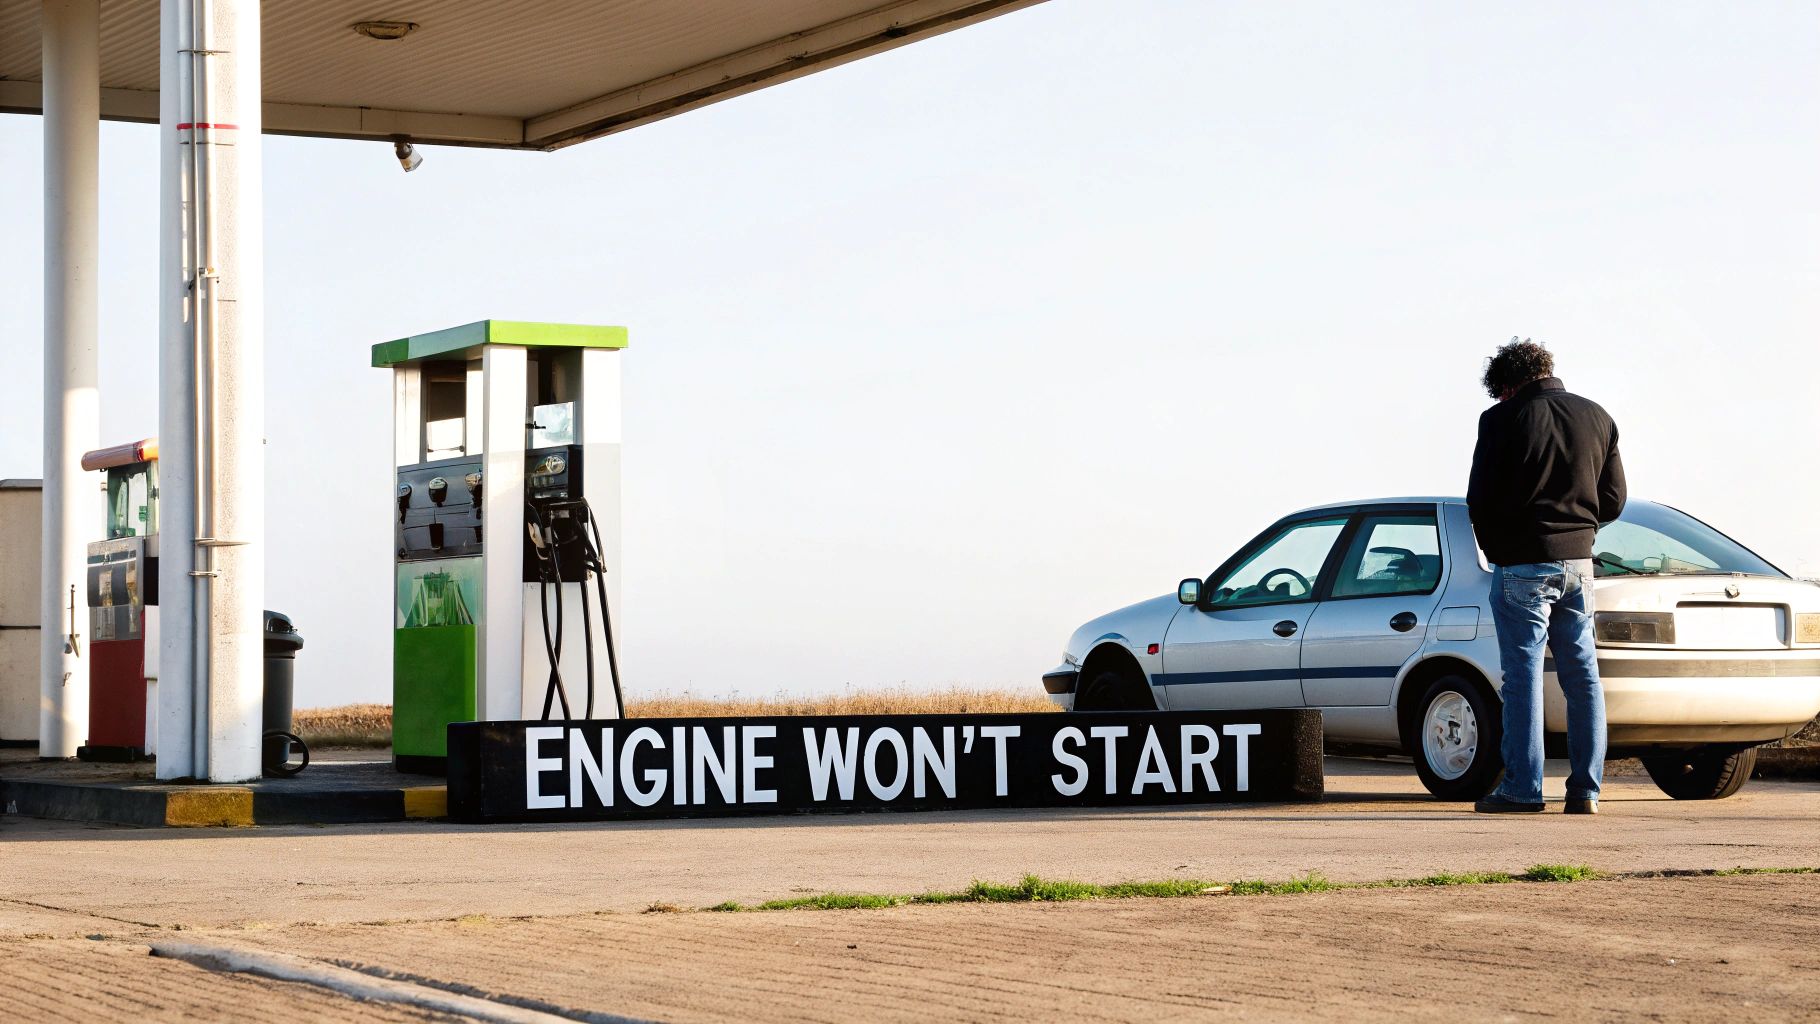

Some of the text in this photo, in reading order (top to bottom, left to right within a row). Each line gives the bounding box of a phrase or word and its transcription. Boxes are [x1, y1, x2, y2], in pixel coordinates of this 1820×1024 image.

[525, 723, 1262, 809] ENGINE WON'T START
